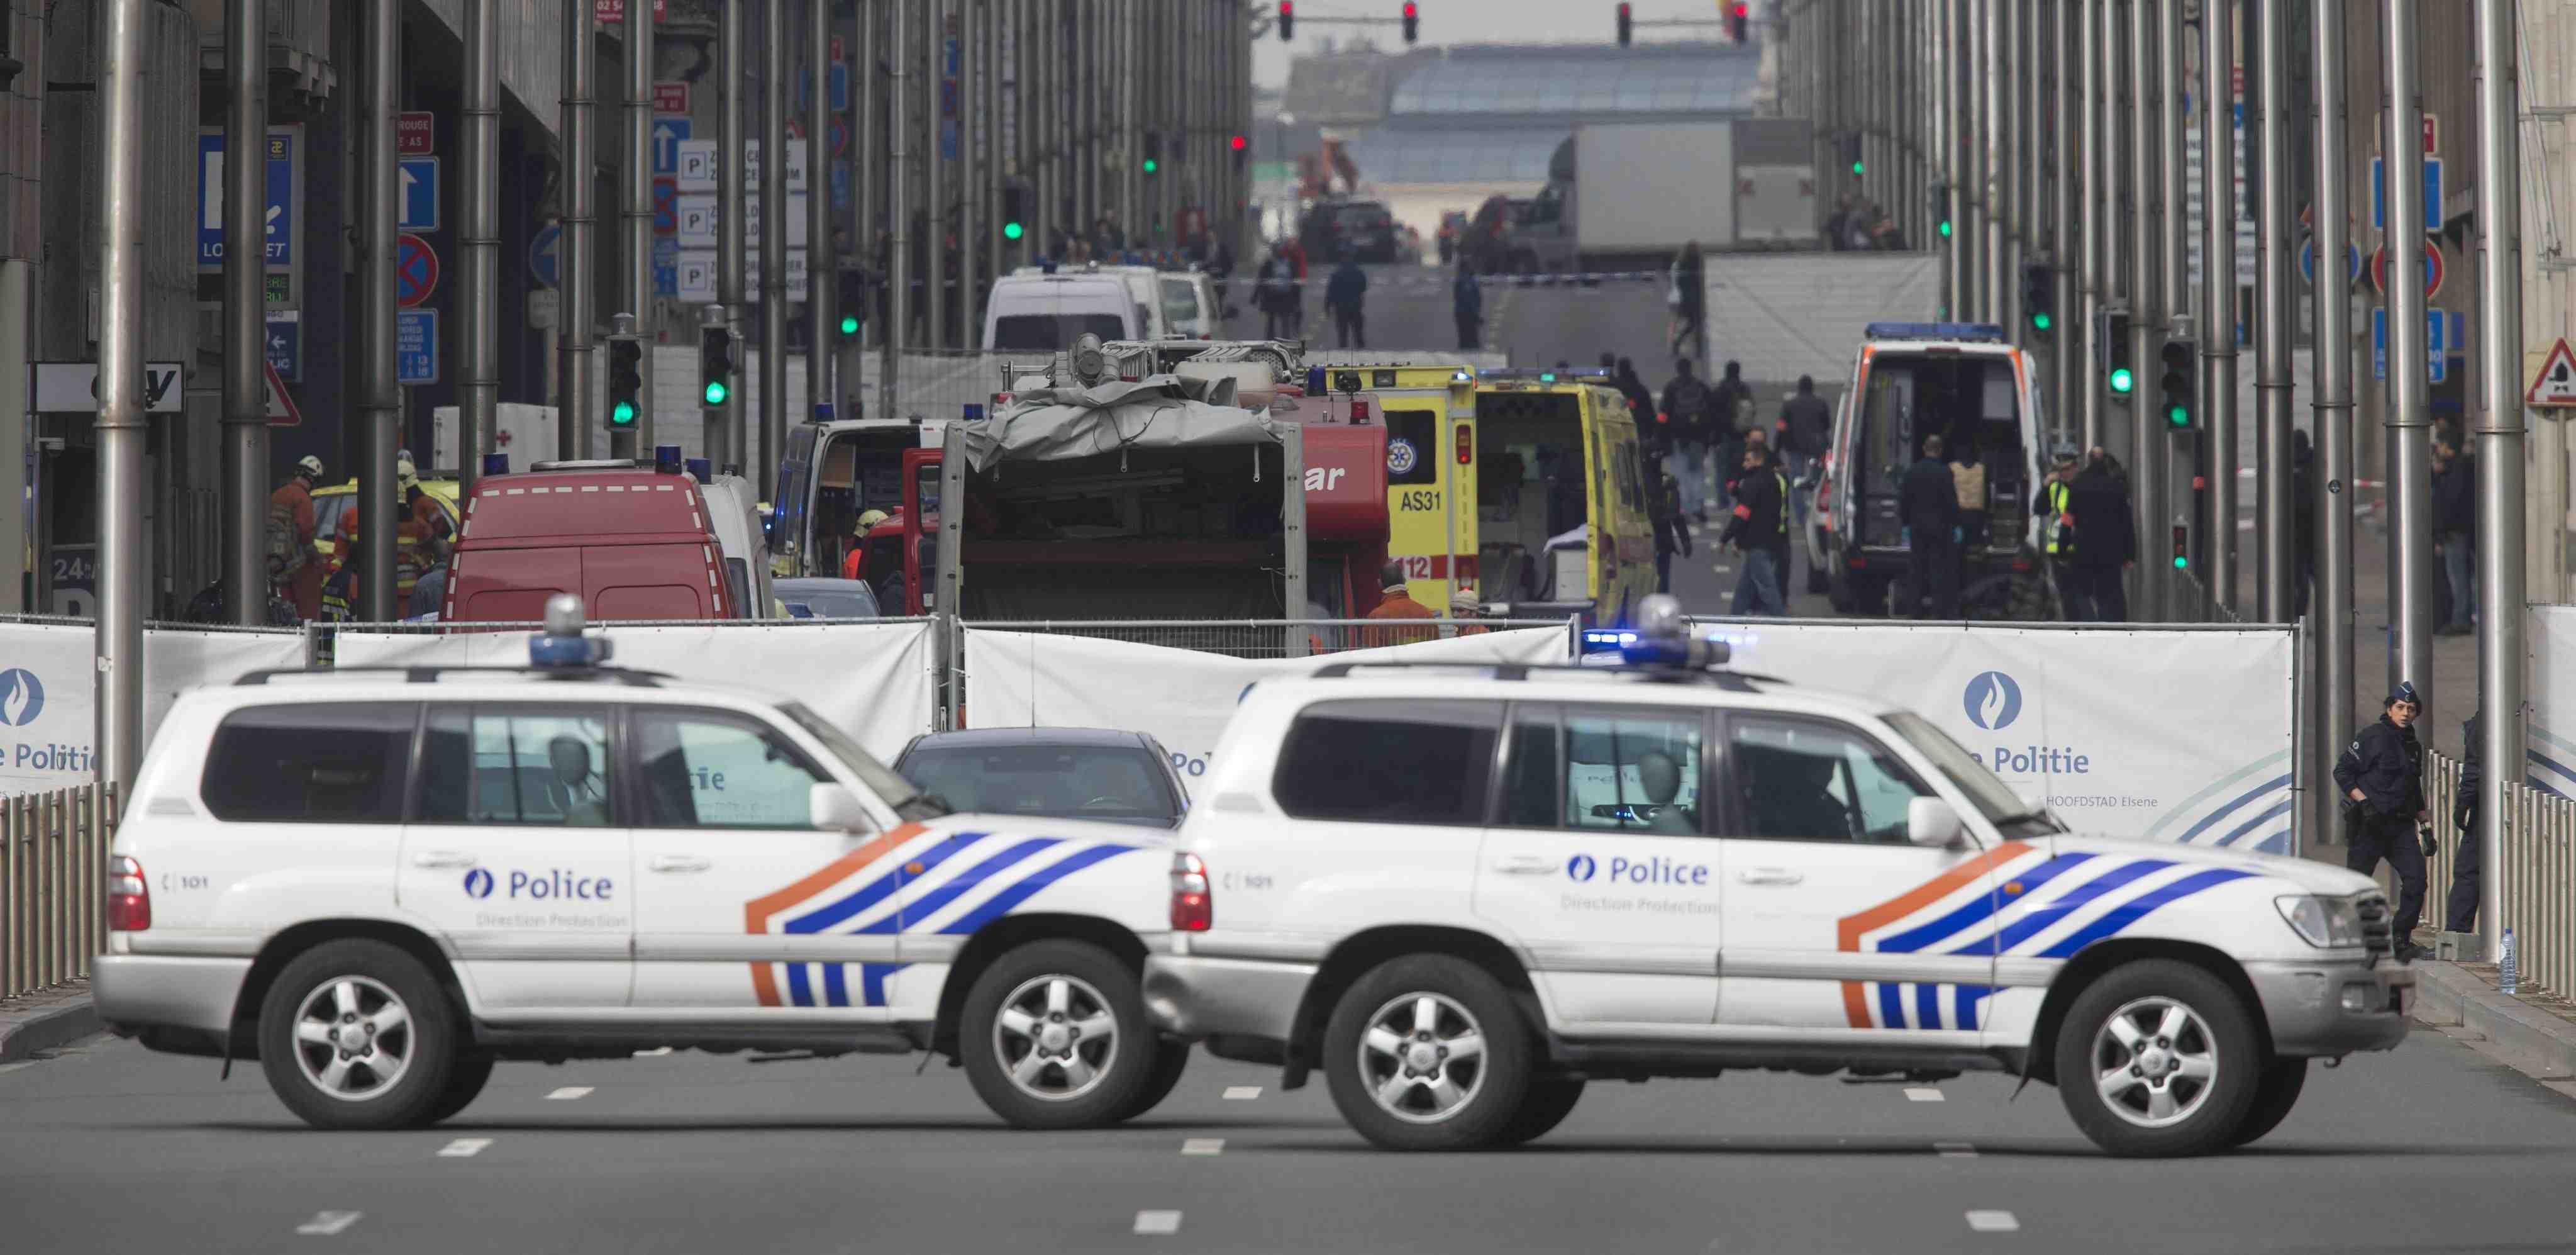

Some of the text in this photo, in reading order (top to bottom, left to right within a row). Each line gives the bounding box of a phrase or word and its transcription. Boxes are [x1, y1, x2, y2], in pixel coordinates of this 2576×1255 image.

[689, 159, 700, 173] P
[689, 213, 700, 229] P
[203, 243, 286, 257] LO ET
[689, 269, 700, 284] P
[1401, 491, 1440, 511] AS31
[1994, 745, 2089, 774] Politie
[2046, 796, 2159, 808] HOOFDSTAD Elsene
[1611, 856, 1709, 886] Police
[509, 868, 613, 900] Police
[1560, 894, 1721, 916] Direction Protection
